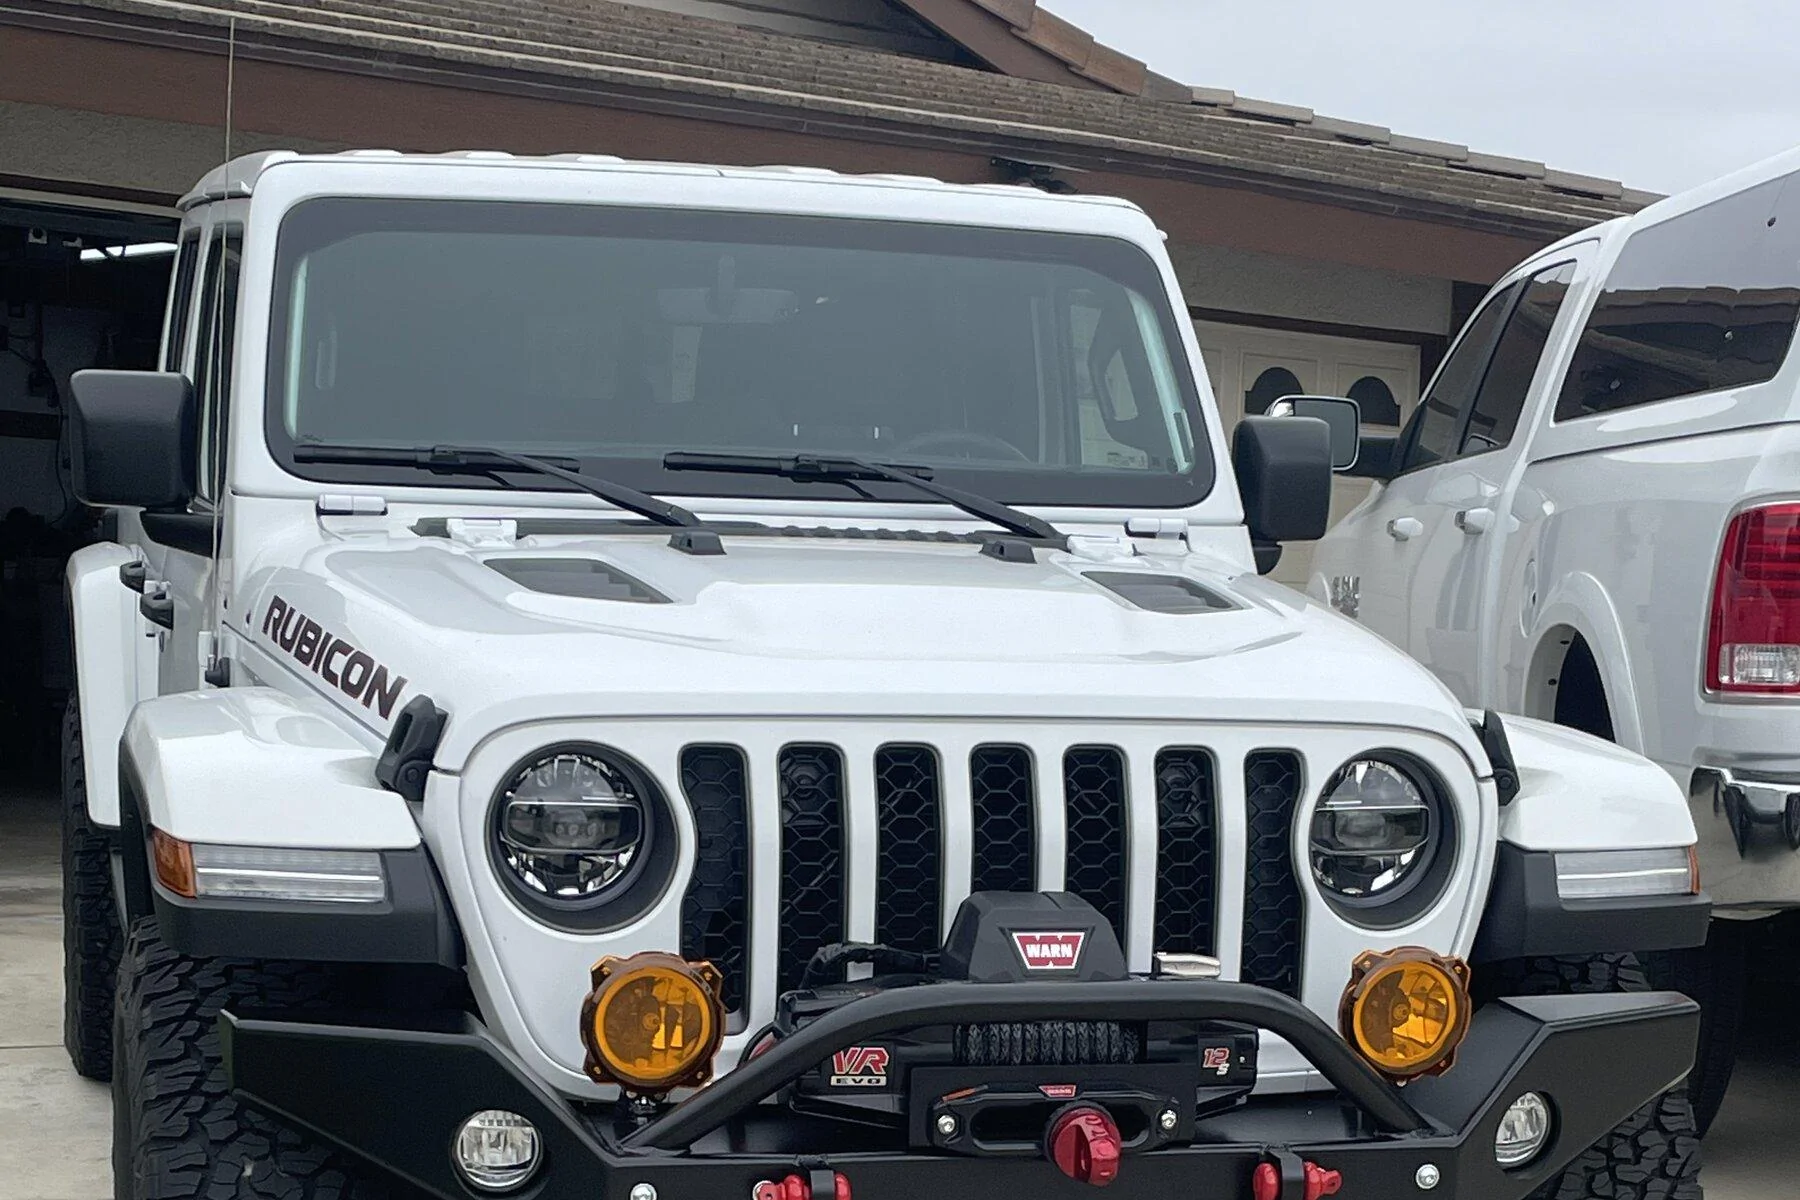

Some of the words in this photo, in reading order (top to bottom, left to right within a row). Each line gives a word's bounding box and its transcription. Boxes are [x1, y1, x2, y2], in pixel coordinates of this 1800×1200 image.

[261, 594, 408, 721] RUBICON
[1025, 943, 1073, 958] WARN
[832, 1047, 890, 1075] VR
[1202, 1047, 1230, 1068] 12
[835, 1077, 882, 1085] EVO
